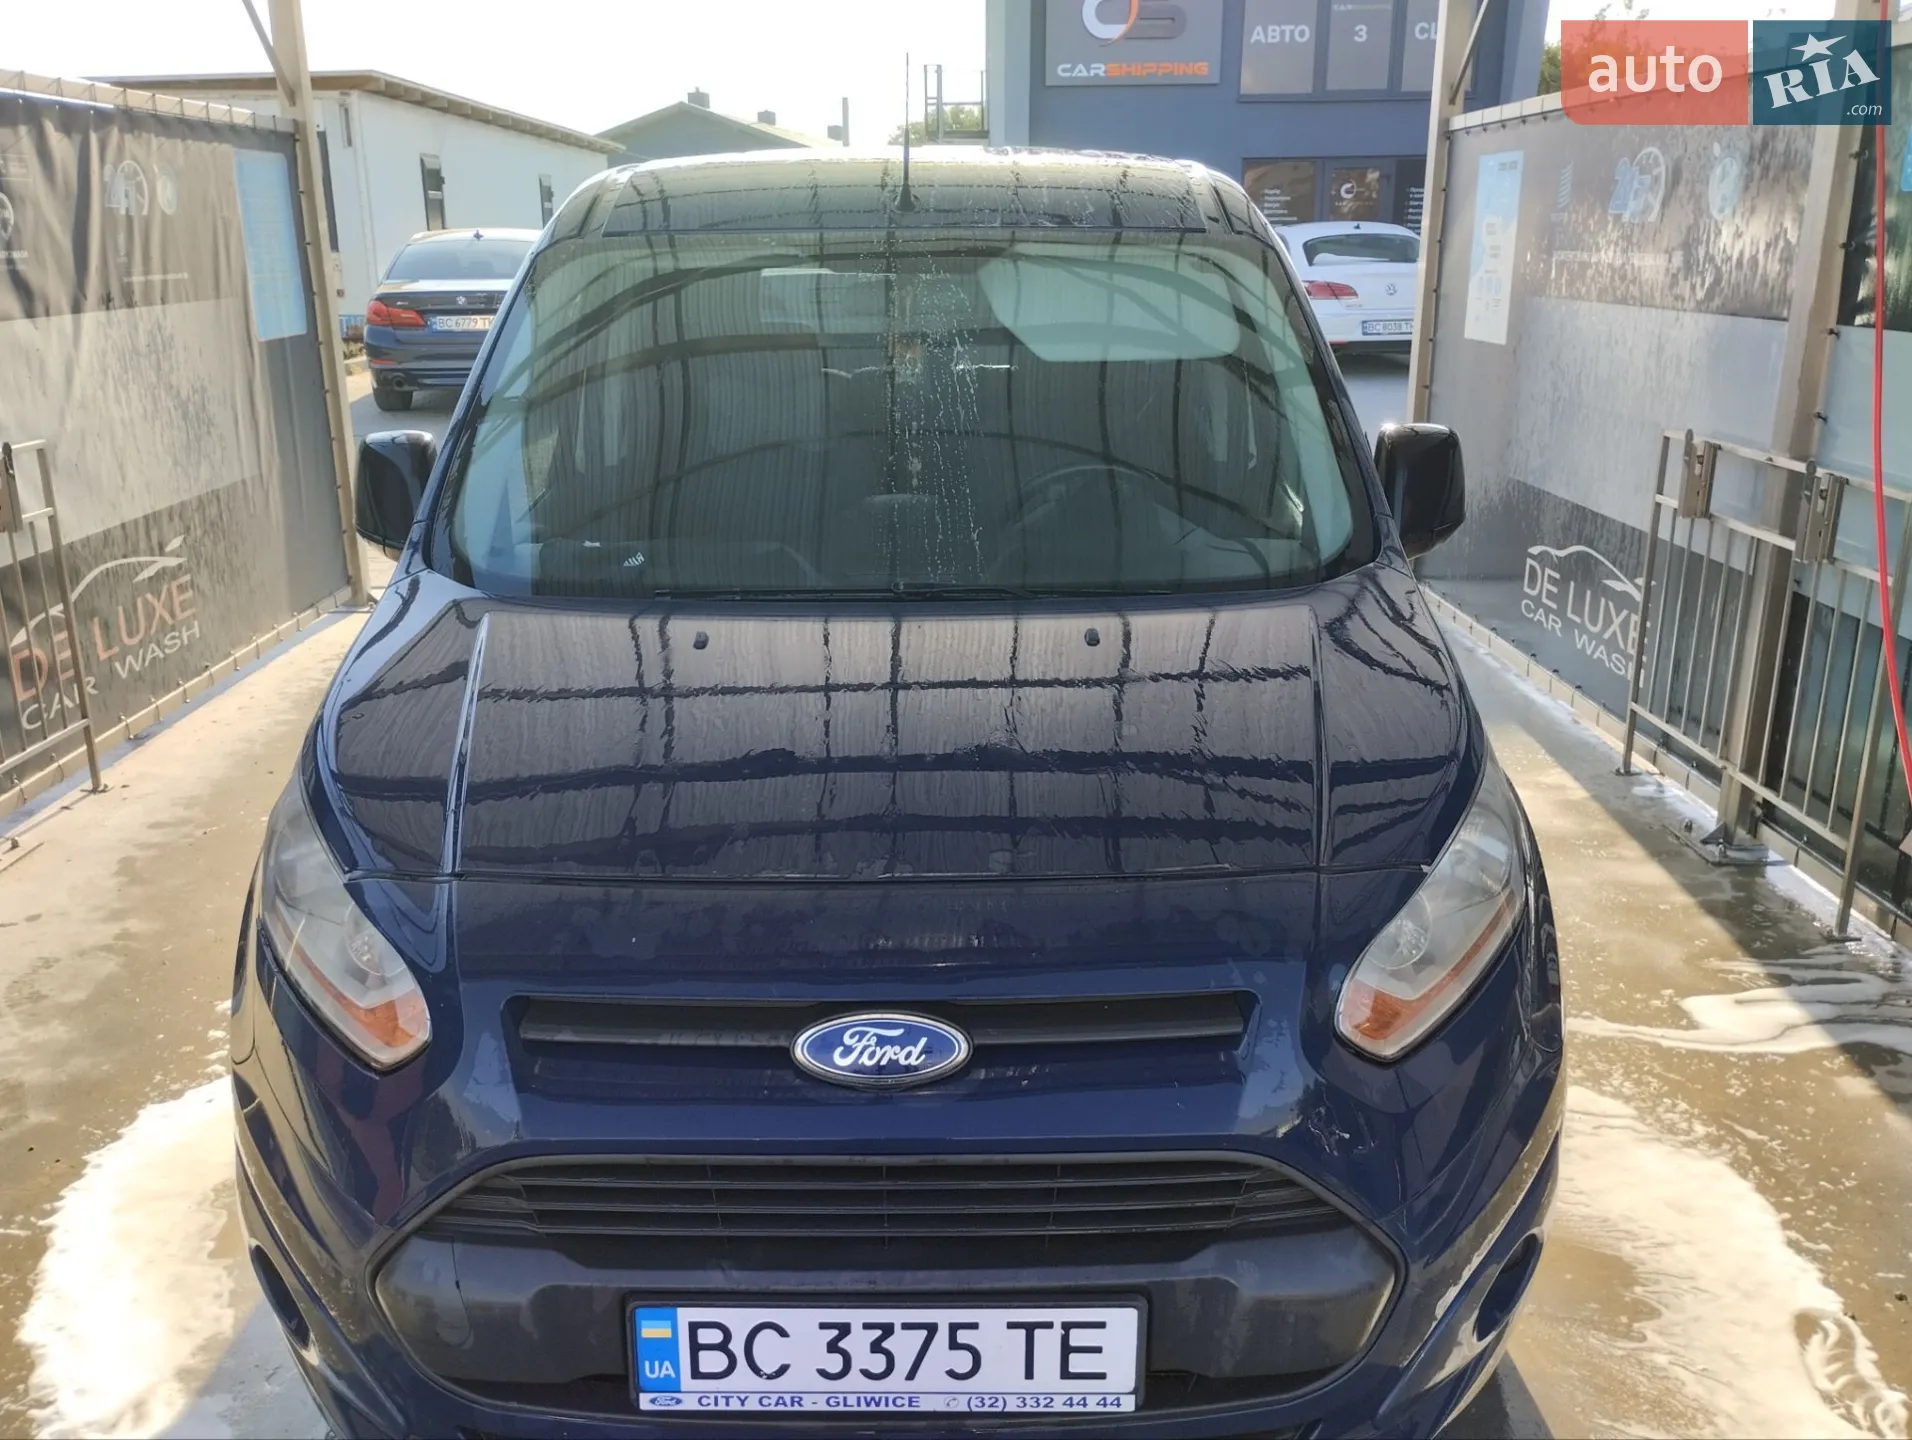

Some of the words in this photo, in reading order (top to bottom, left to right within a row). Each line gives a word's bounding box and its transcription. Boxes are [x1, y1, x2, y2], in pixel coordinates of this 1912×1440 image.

[1250, 25, 1311, 43] АВТО
[1056, 61, 1210, 77] CARSHIPPING
[1523, 557, 1560, 610] DE
[93, 574, 196, 661] LUXE
[1521, 599, 1562, 637] CAR
[115, 620, 200, 679] WASH
[833, 1027, 928, 1067] Ford
[644, 1360, 676, 1379] UA
[688, 1320, 791, 1381] BC
[815, 1320, 982, 1381] 3375
[1006, 1320, 1108, 1381] TE
[697, 1395, 750, 1408] CITY
[758, 1395, 804, 1408] CAR
[825, 1395, 921, 1408] GLIWICE
[966, 1395, 1008, 1412] (32)
[1016, 1395, 1055, 1408] 332
[1062, 1395, 1089, 1408] 44
[1095, 1395, 1123, 1408] 44
